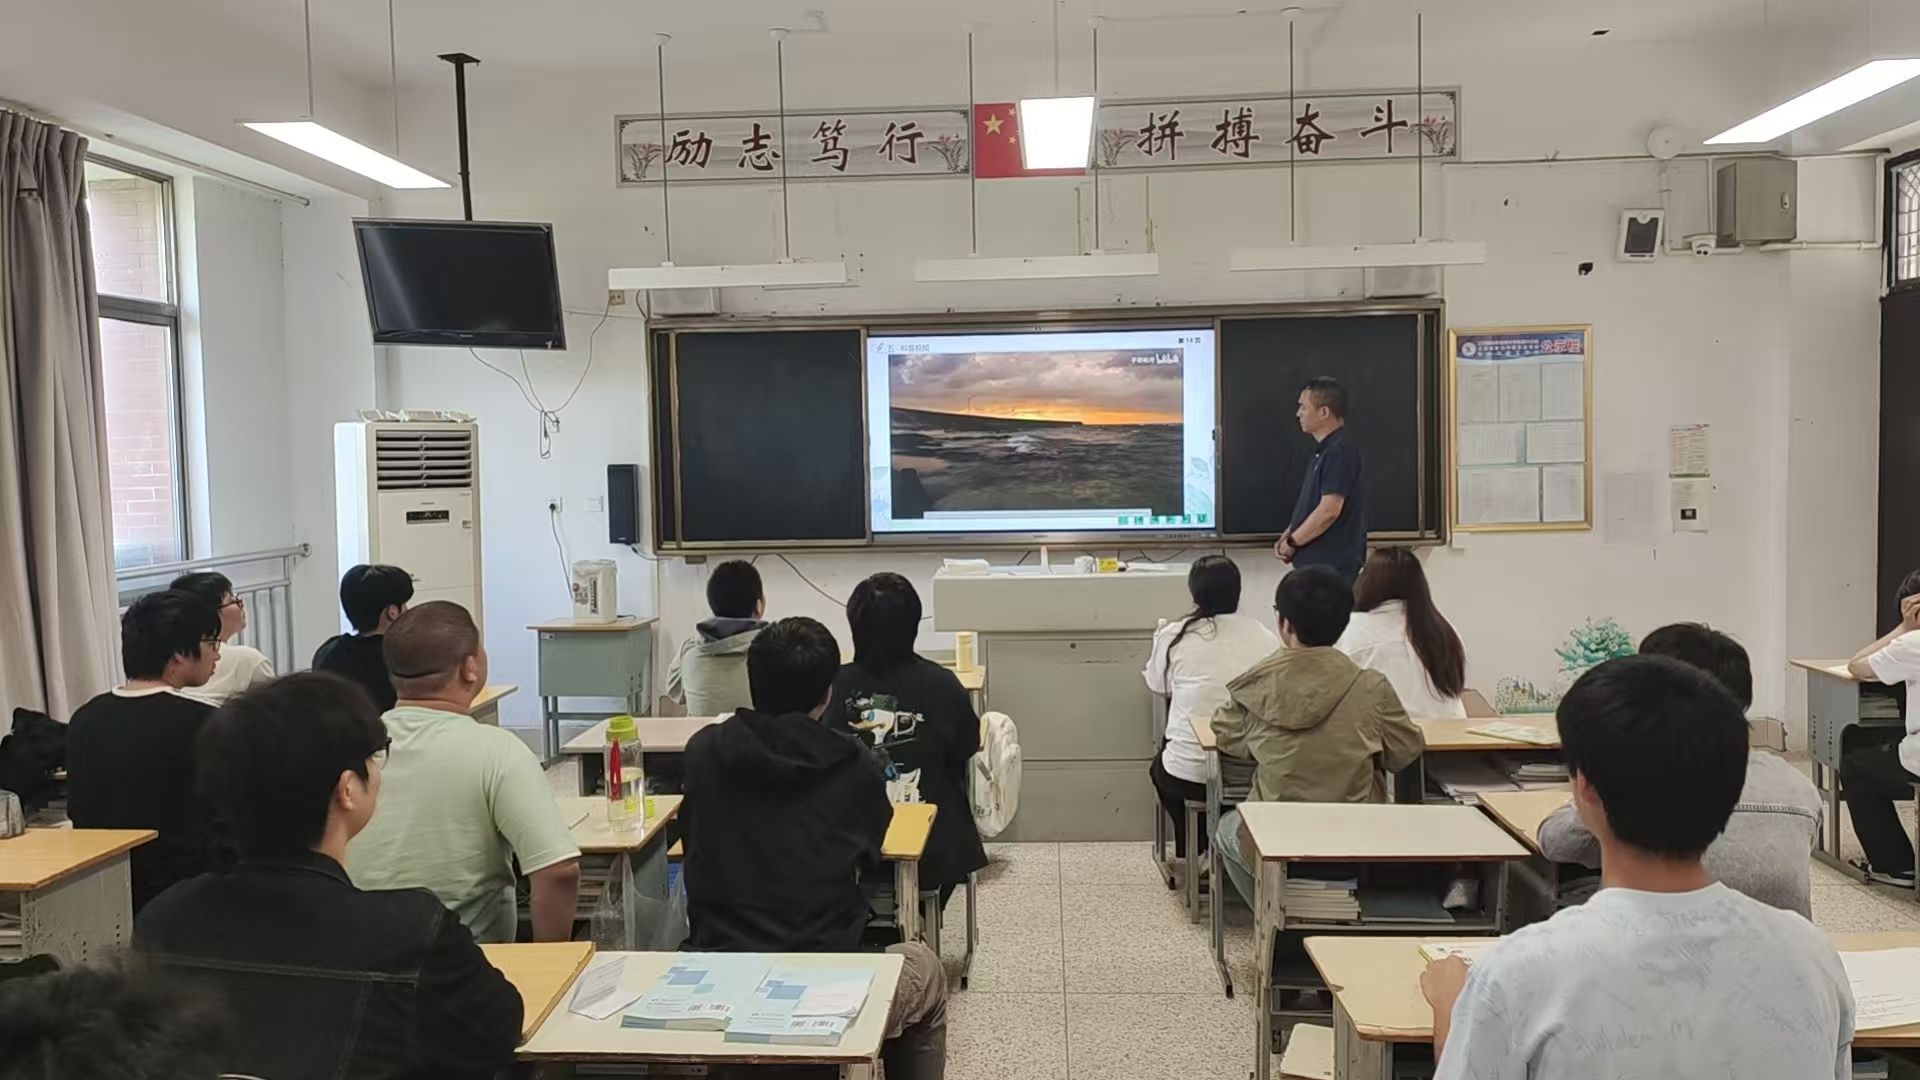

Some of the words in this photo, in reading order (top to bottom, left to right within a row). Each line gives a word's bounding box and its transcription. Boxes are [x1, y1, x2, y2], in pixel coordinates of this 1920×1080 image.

[665, 119, 924, 172] 励志笃行
[1137, 99, 1409, 161] 拼搏奋斗
